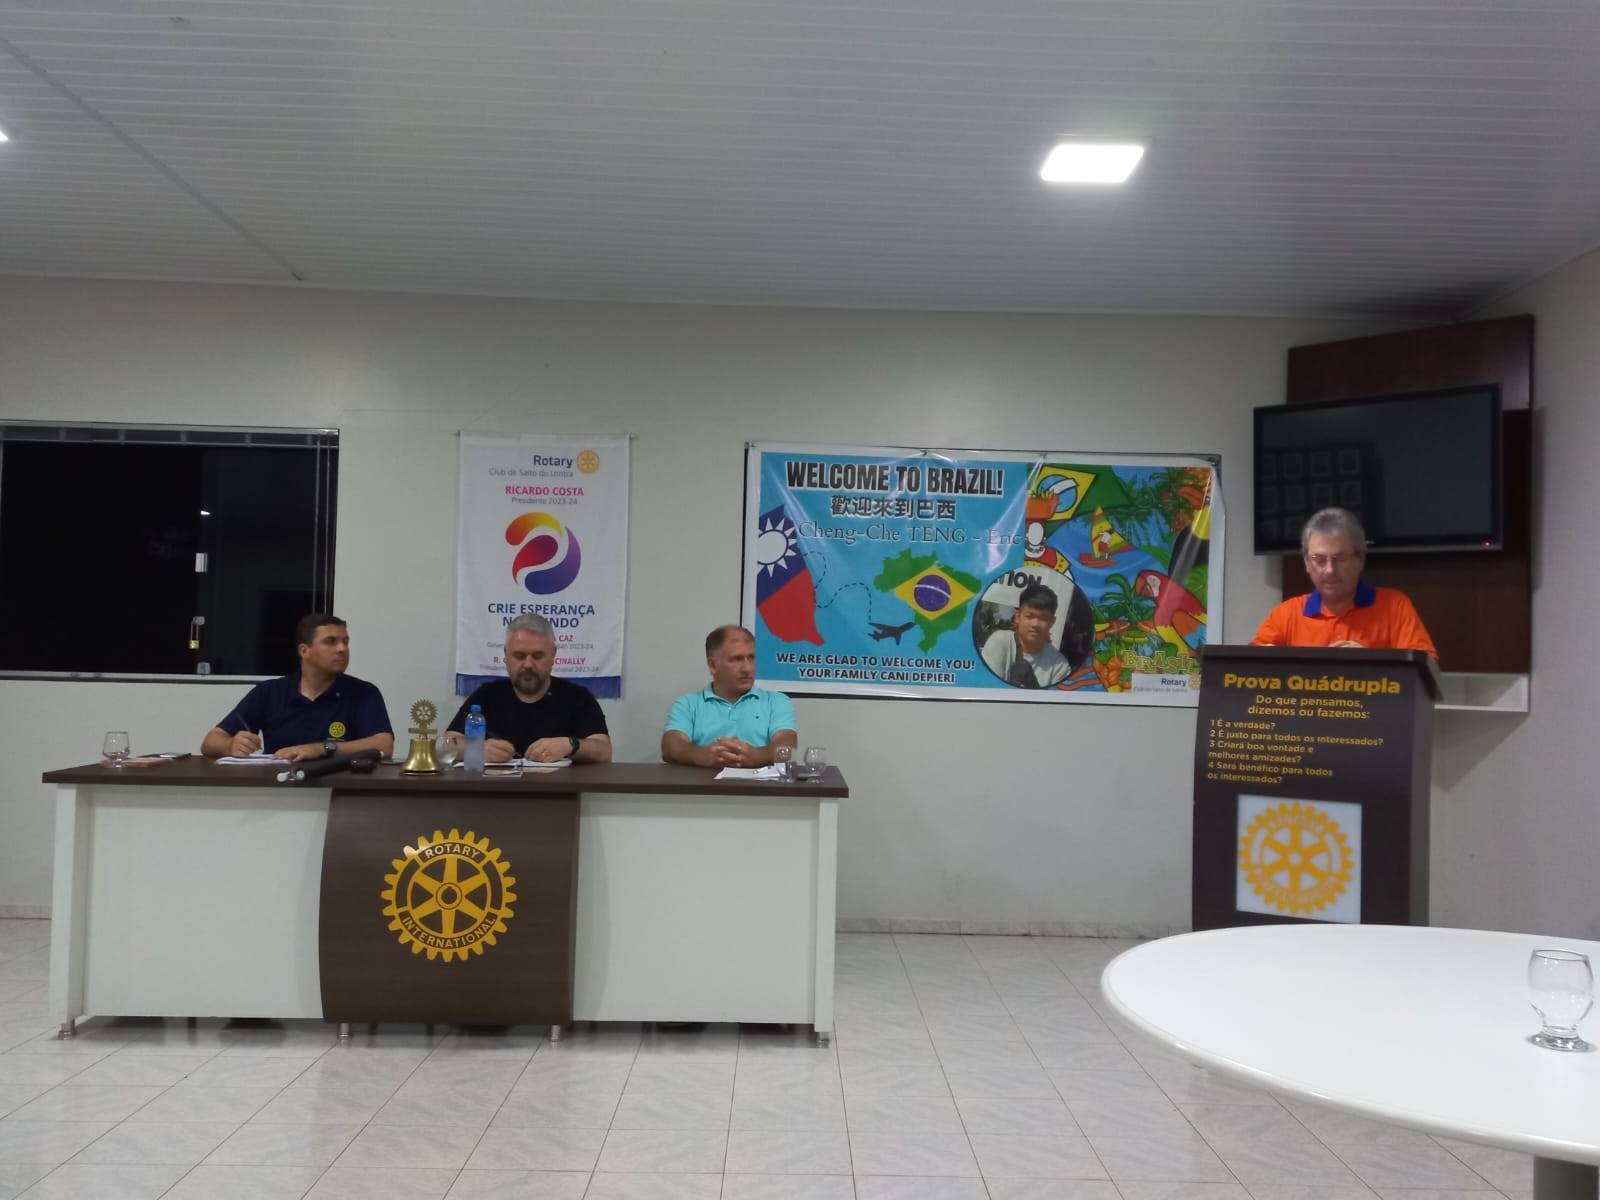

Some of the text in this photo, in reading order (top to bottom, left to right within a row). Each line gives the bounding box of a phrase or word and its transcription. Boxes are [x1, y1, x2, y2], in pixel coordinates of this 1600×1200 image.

[533, 455, 573, 469] Rotary
[787, 461, 1003, 495] WELCOME TO BRAZIL!
[505, 486, 584, 496] RICARDO COSTA
[832, 495, 956, 520] 歡迎來到巴西
[800, 521, 900, 545] Cheng-Che
[909, 526, 965, 543] TENG
[488, 603, 595, 618] CRIE ESPERANÇA
[549, 618, 579, 628] NDO
[777, 653, 975, 670] WE ARE GLAD TO WELCOME YOU!
[800, 668, 831, 678] YOUR
[835, 669, 877, 680] FAMILY
[881, 671, 909, 681] CANI
[1161, 678, 1187, 687] Rotary
[1224, 673, 1400, 695] Prova Quádrupla
[1256, 695, 1363, 709] Do que pensamos,
[1248, 706, 1371, 719] dizemos ou fazemos:
[1233, 721, 1276, 730] verdade?
[1210, 729, 1216, 737] 2
[1226, 731, 1249, 739] justo
[1274, 733, 1301, 742] todos
[1317, 736, 1384, 746] interessados?
[1247, 742, 1264, 750] boa
[1267, 744, 1306, 753] vontade
[1208, 751, 1302, 763] melhores amizades?
[1282, 767, 1303, 775] para
[1306, 768, 1333, 777] todos
[425, 843, 481, 859] ROTARY
[402, 916, 496, 948] INTERNATIONAL
